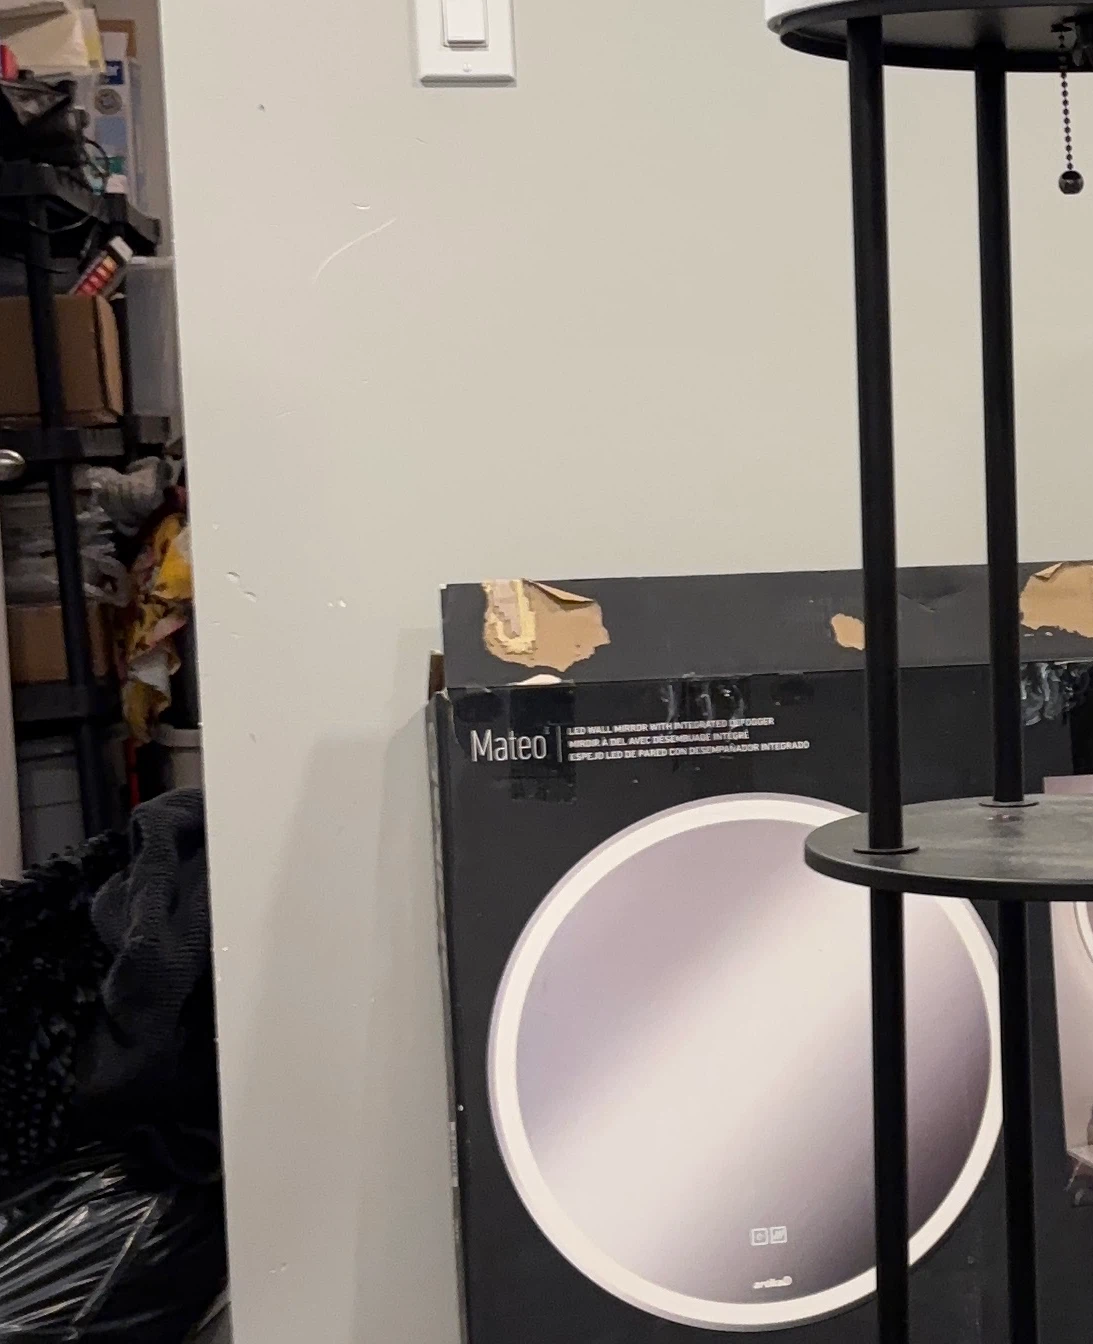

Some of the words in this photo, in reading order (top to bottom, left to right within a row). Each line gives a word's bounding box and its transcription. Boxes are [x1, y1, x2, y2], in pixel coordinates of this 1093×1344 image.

[567, 727, 586, 736] LED
[588, 726, 612, 734] WALL
[614, 724, 648, 733] MIRROR
[650, 723, 672, 731] WITH
[674, 719, 727, 730] INTEGRATED
[470, 729, 547, 763] Mateo
[568, 739, 600, 748] MIROIR
[609, 738, 627, 746] DEL
[629, 736, 651, 745] AVEC
[568, 752, 604, 762] ESPEJO
[605, 751, 623, 760] LED
[624, 750, 637, 759] DE
[638, 748, 667, 758] PARED
[669, 747, 687, 756] CON
[761, 740, 810, 751] INTEGRADO
